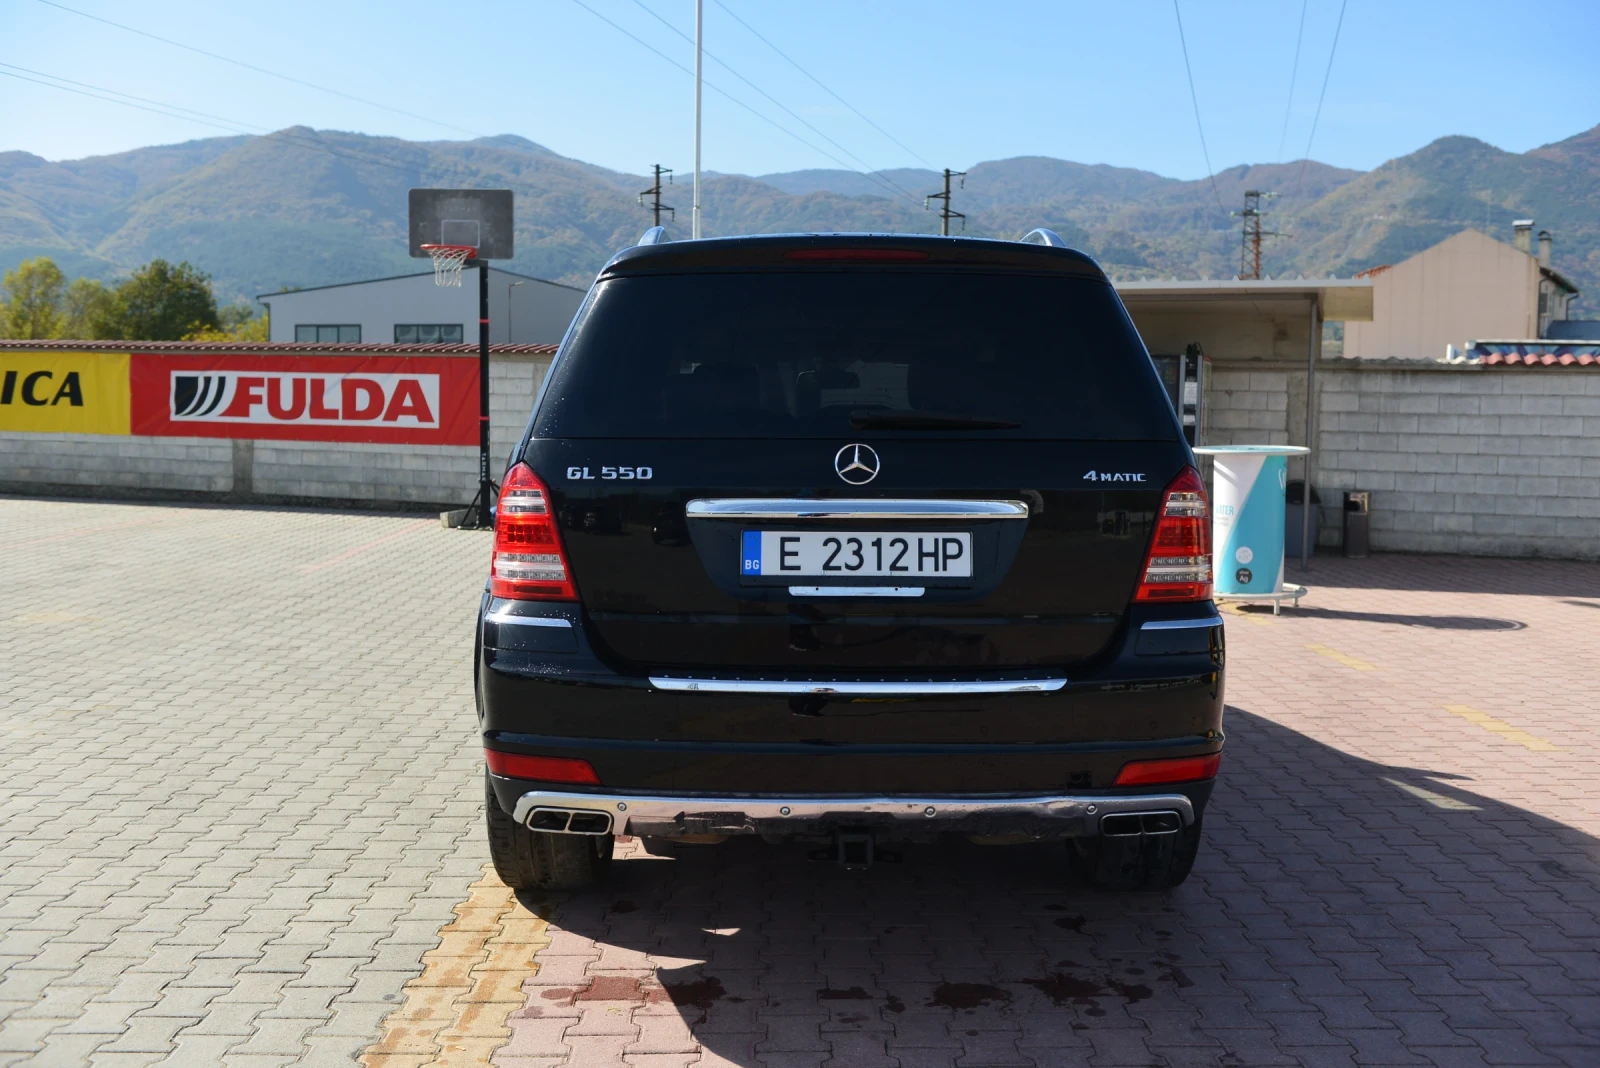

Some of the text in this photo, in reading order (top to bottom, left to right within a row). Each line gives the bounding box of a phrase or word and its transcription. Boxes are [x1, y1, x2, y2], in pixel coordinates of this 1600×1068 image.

[0, 370, 84, 406] ICA
[219, 376, 435, 423] FULDA
[566, 466, 653, 480] GL 550
[744, 559, 760, 570] BG
[779, 536, 802, 571] E
[1239, 575, 1249, 583] Ag
